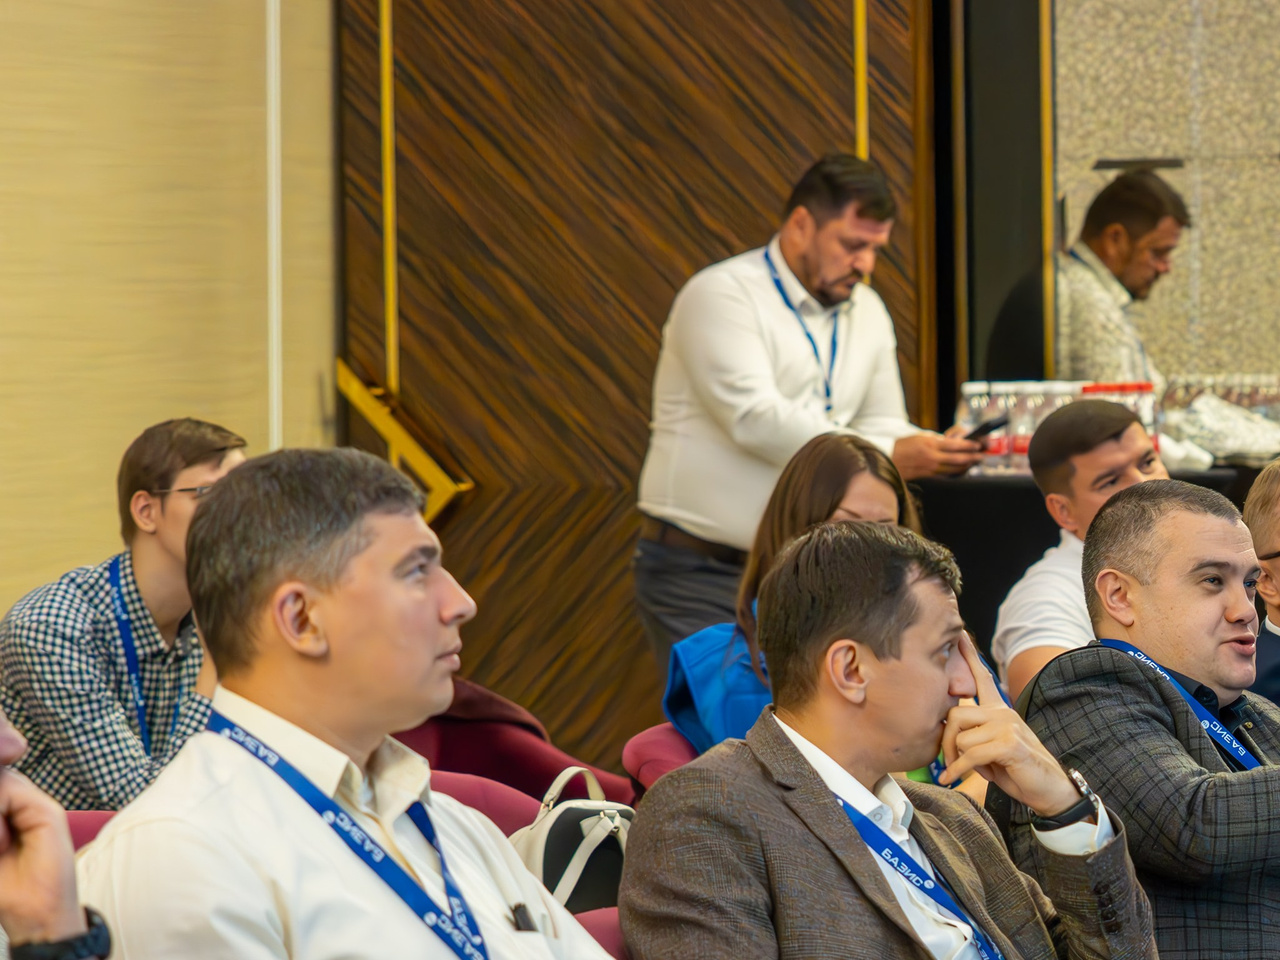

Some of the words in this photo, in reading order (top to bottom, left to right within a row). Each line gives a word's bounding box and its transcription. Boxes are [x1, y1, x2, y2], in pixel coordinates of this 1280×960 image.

[231, 726, 280, 767] БАЗИС
[1210, 721, 1246, 757] БАЗИС
[335, 811, 386, 863] БАЗИС
[881, 847, 924, 888] БАЗИС
